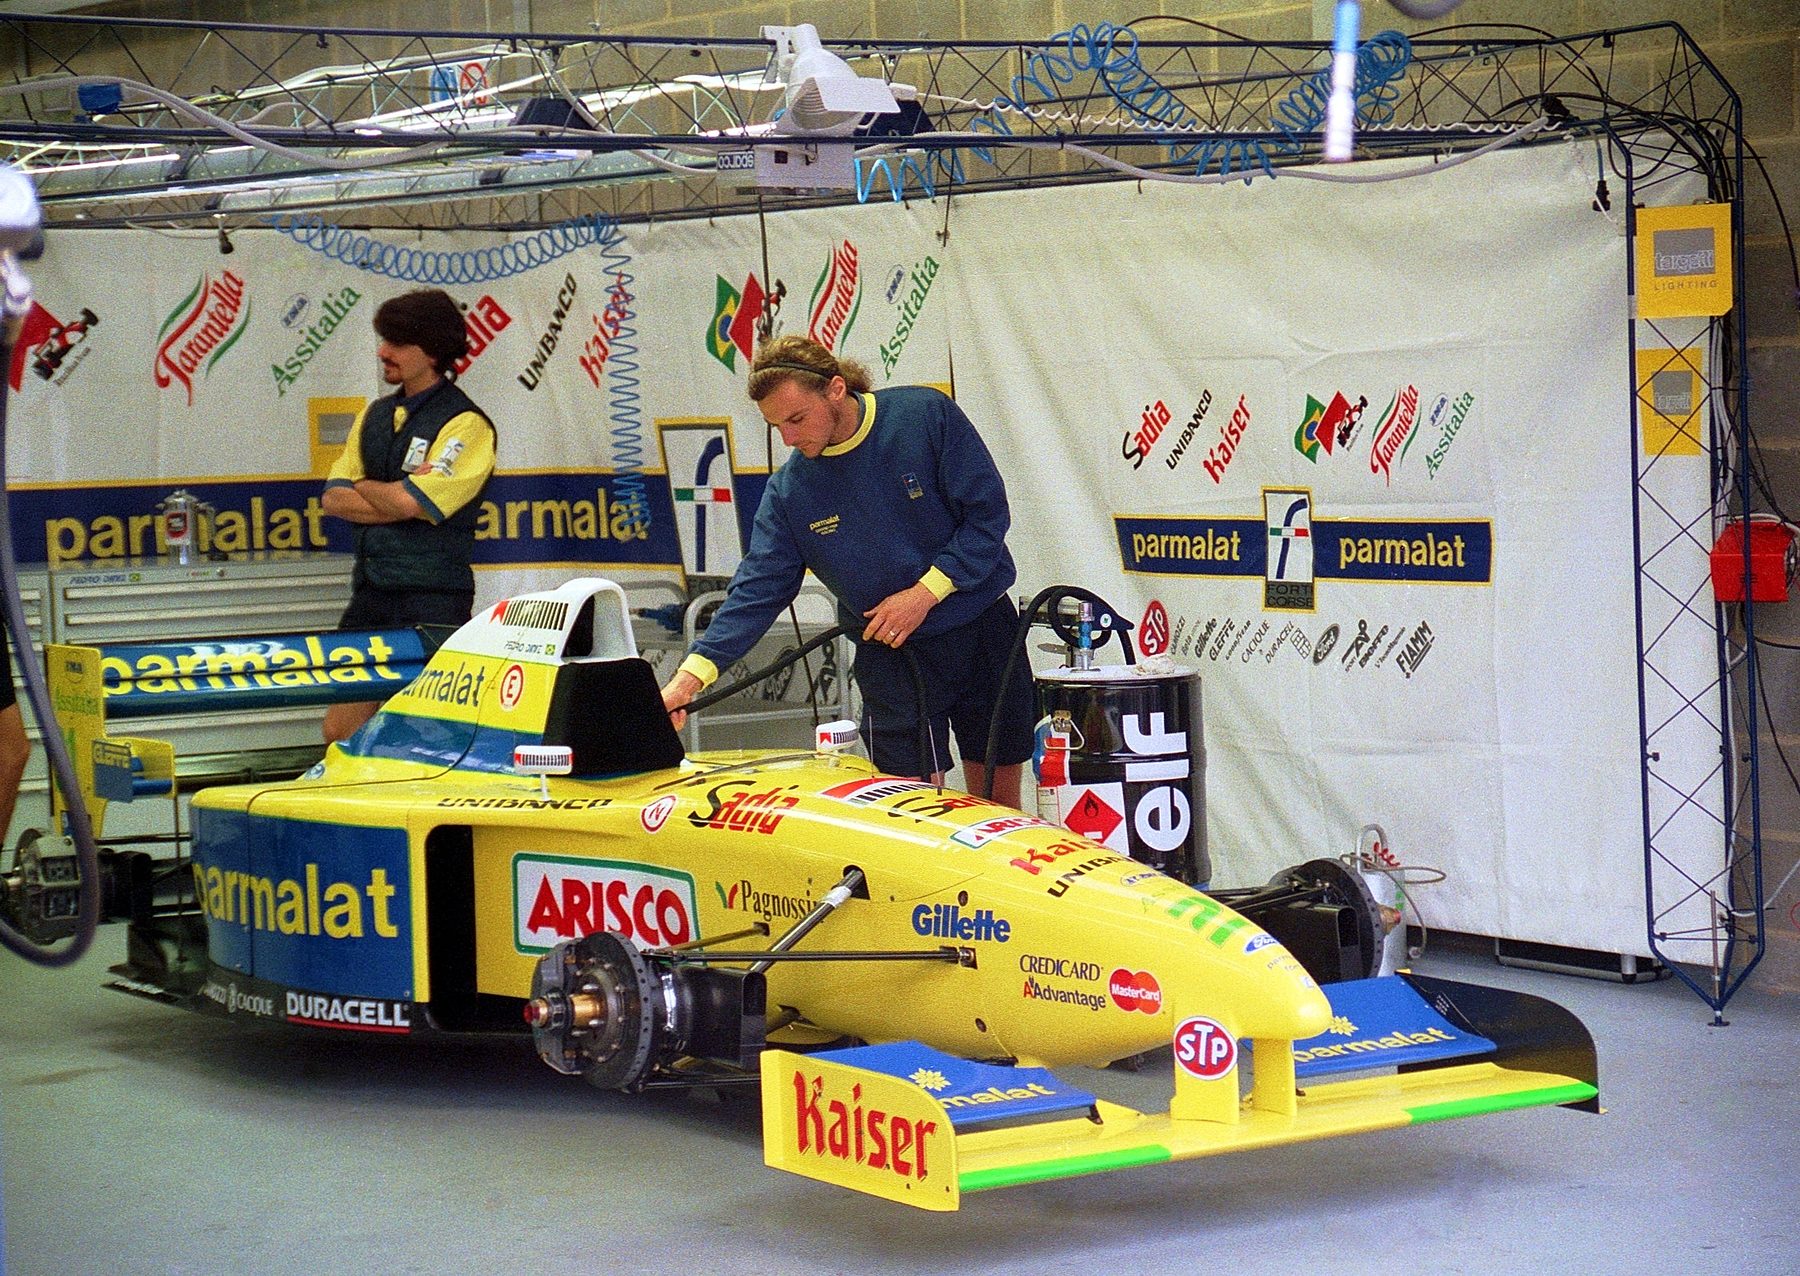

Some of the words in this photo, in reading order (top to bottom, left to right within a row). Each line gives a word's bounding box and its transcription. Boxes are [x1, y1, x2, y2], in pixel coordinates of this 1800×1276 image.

[1653, 279, 1717, 291] LIGHTING
[154, 269, 245, 406] Tarantella
[271, 287, 362, 397] Assitalia
[517, 272, 577, 391] UNIBANCO
[879, 255, 940, 380] Assitalia
[1122, 400, 1172, 470] Sadia
[1165, 388, 1213, 470] UNIBANCO
[1203, 394, 1251, 484] Kaiser
[1370, 384, 1419, 488] Tarantella
[1424, 391, 1475, 480] Assitalia
[474, 488, 650, 542] armalat
[1132, 529, 1241, 563] parmalat
[1339, 532, 1466, 569] parmalat
[1144, 608, 1166, 654] STP
[1195, 617, 1217, 658] Gillette
[1265, 620, 1295, 664] DURACELL
[1396, 620, 1433, 673] FIAMM
[102, 636, 401, 698] parmalat
[403, 662, 485, 707] rmalat
[437, 797, 613, 810] UNIBANCO
[687, 780, 800, 835] Sadia
[1122, 711, 1191, 852] elf
[192, 863, 398, 939] parmalat
[527, 873, 690, 947] ARISCO
[741, 880, 818, 921] Pagnossi
[912, 904, 1010, 943] Gillette
[1020, 955, 1101, 982] CREDICARD
[1111, 983, 1161, 1002] MasterCard
[286, 991, 411, 1028] DURACELL
[1178, 1024, 1229, 1067] STP
[1293, 1027, 1456, 1063] parmalat
[942, 1083, 1056, 1109] malat
[793, 1070, 938, 1181] Kaiser
